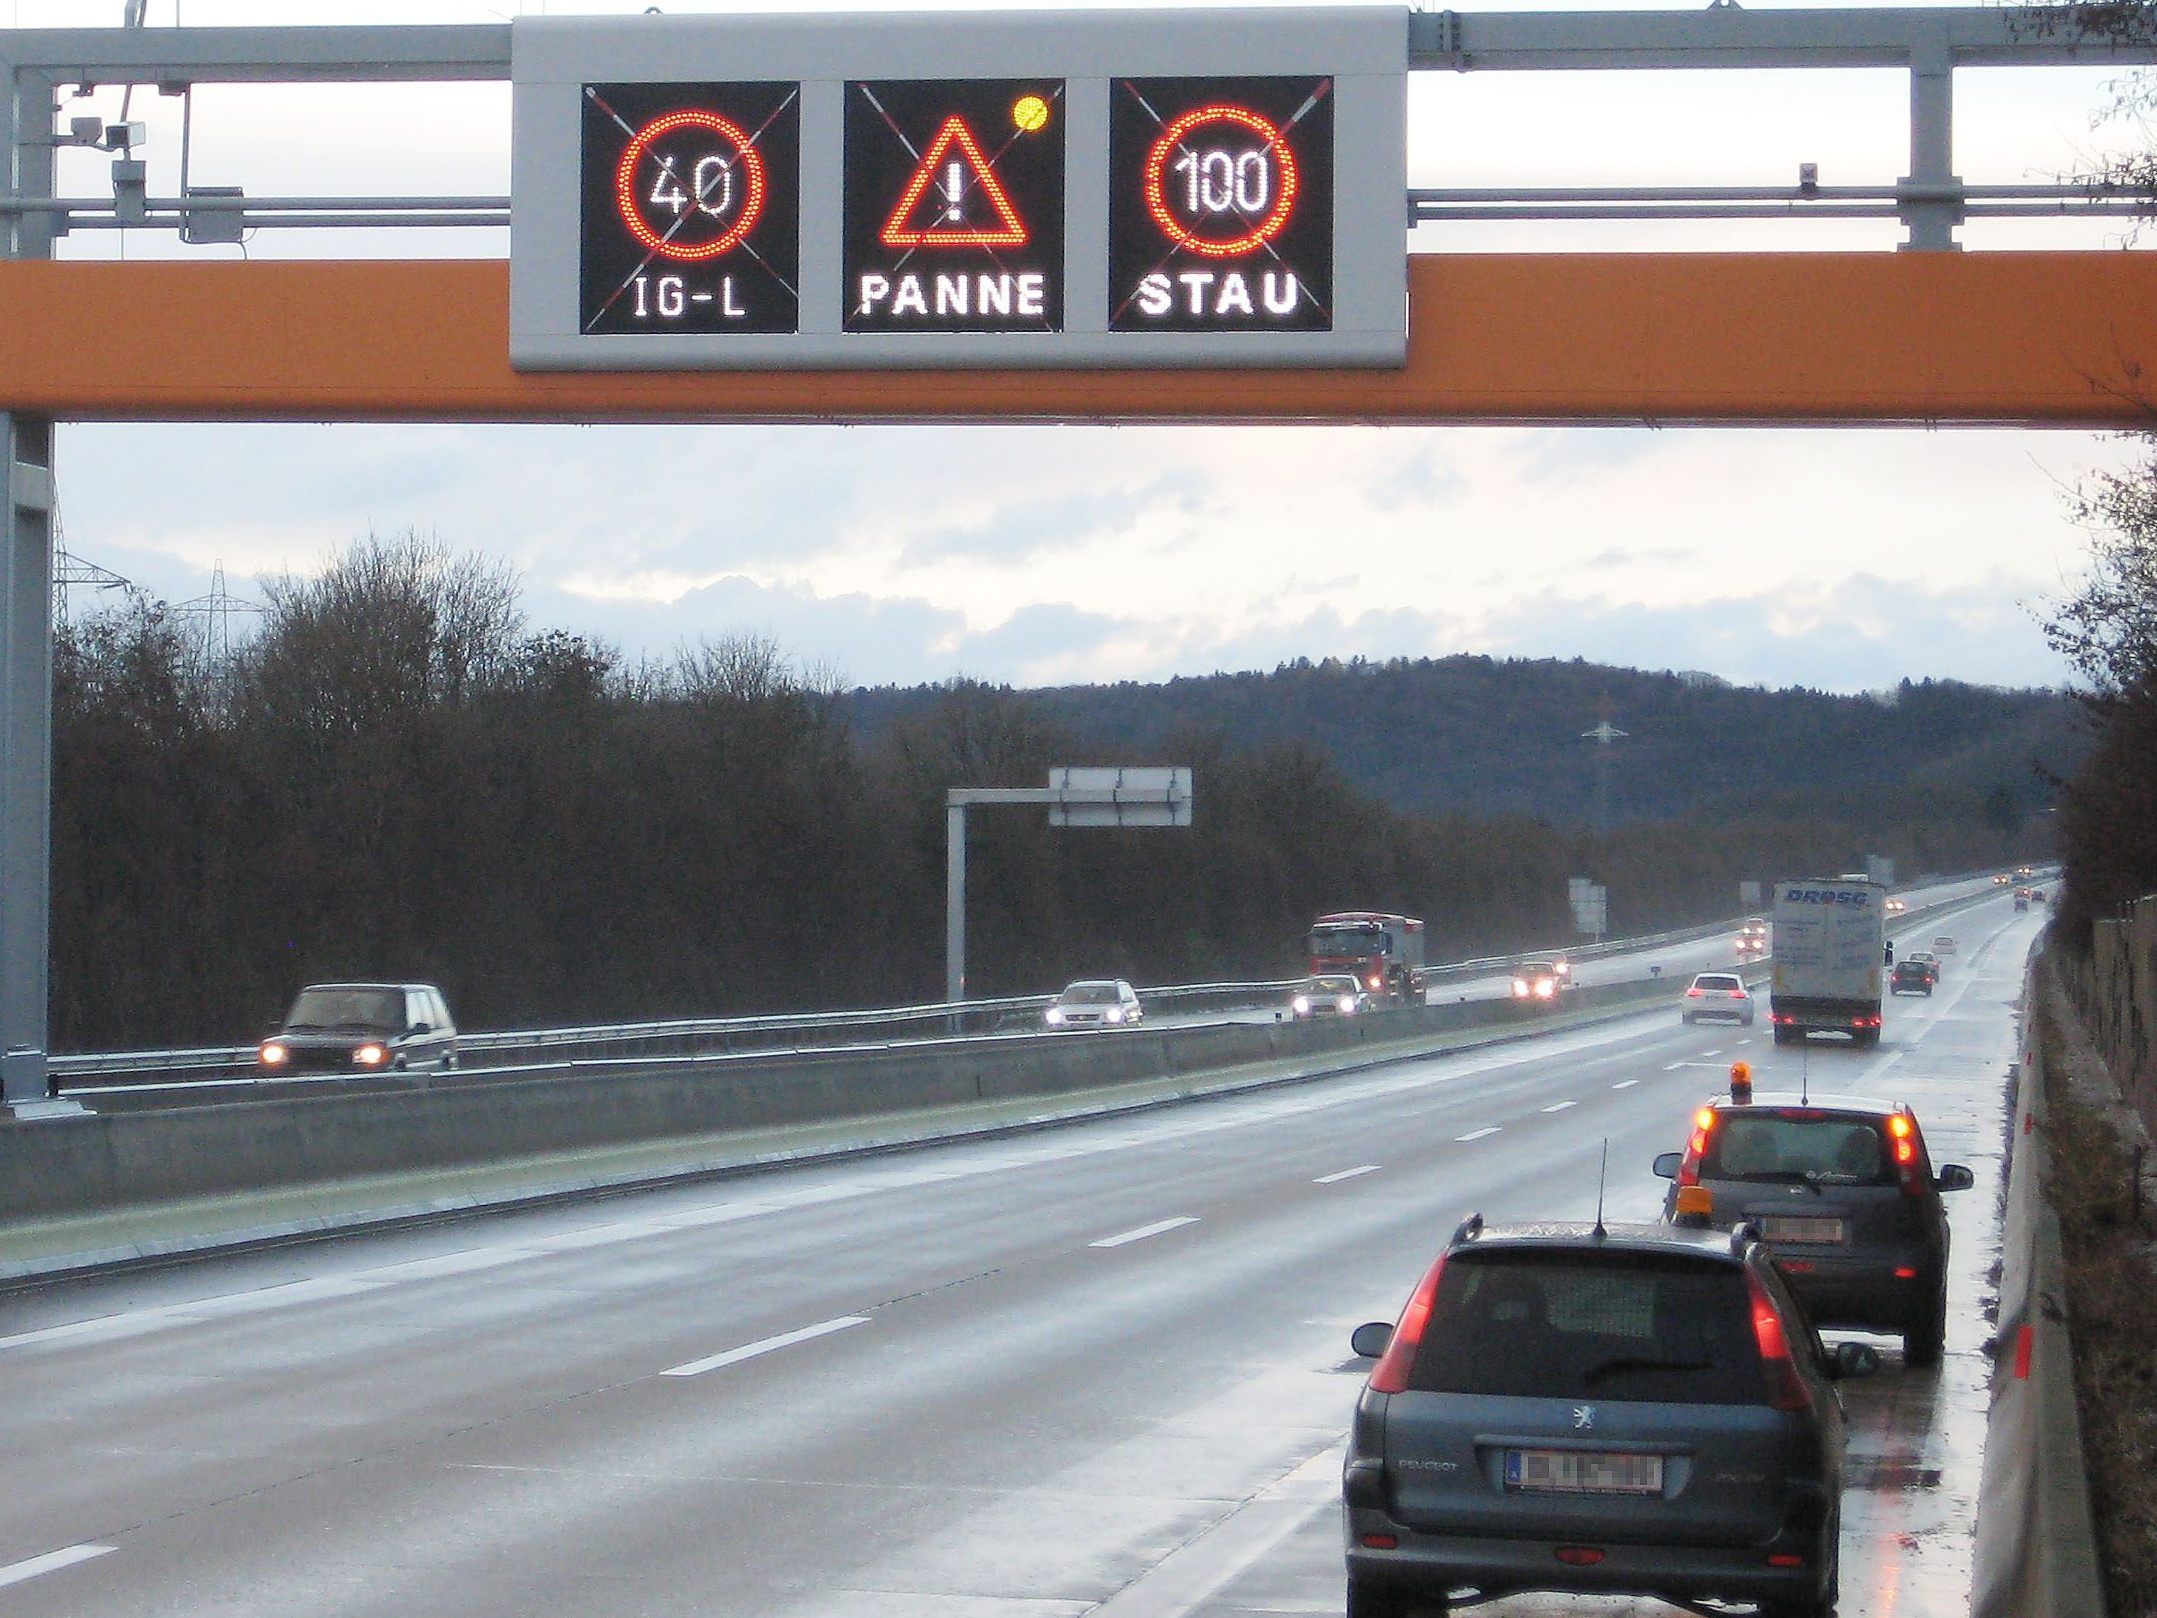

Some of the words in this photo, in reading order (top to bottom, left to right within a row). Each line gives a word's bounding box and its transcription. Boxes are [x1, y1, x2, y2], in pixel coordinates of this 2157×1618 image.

[650, 156, 730, 215] 40
[1175, 151, 1267, 212] 100
[634, 276, 746, 316] IG-L
[861, 274, 1043, 314] PANNE
[1138, 273, 1297, 314] STAU
